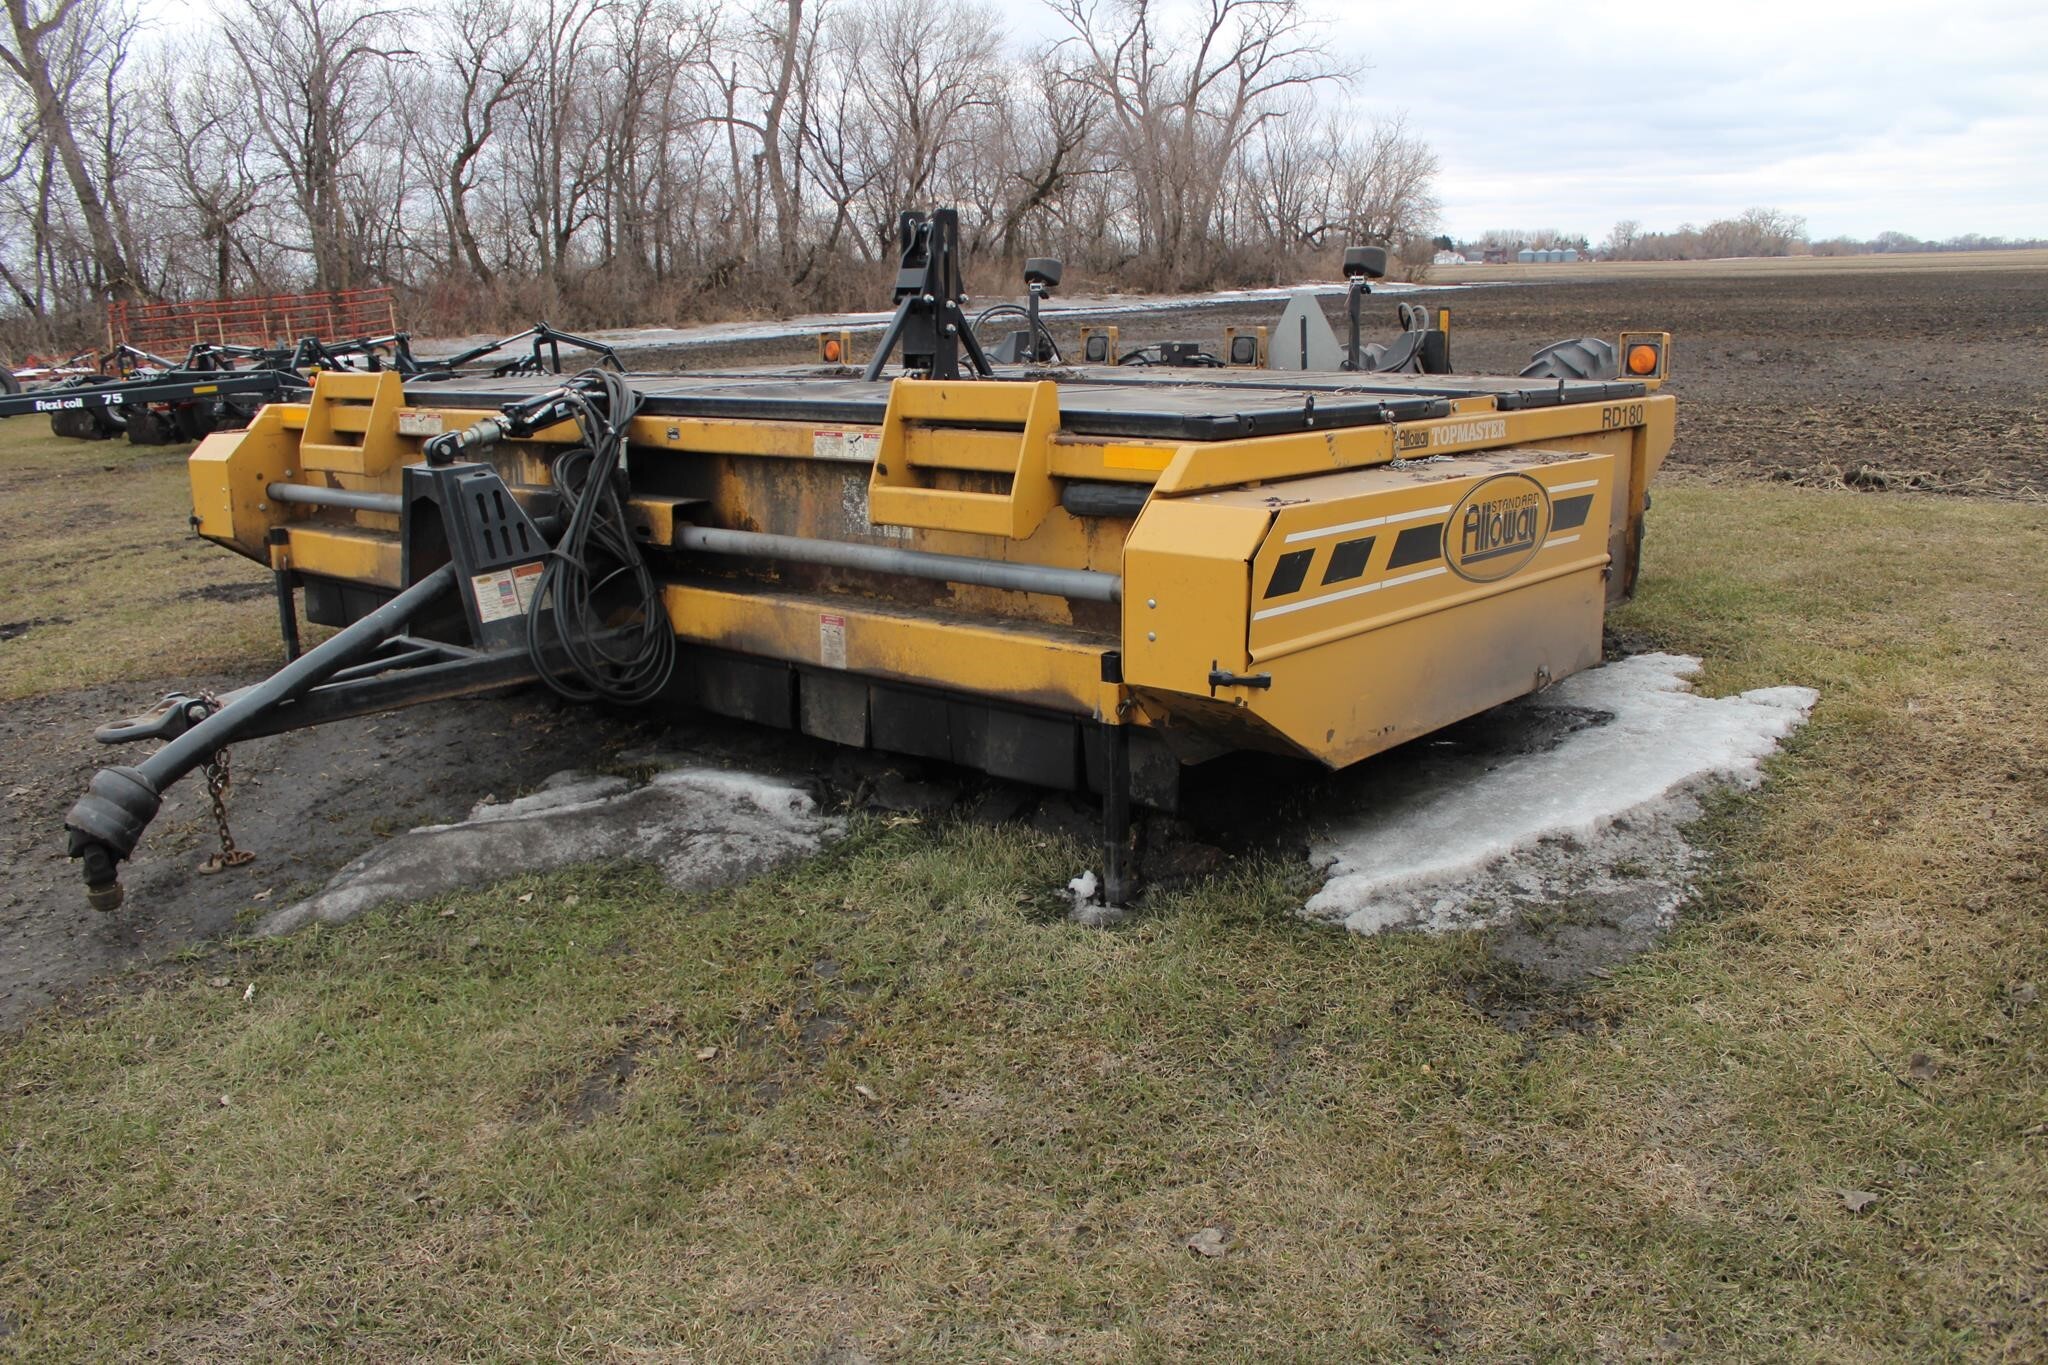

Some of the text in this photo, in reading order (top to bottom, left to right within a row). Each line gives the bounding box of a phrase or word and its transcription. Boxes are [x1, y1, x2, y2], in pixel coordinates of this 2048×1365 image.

[101, 393, 123, 405] 75
[1601, 405, 1643, 429] RD180
[1399, 419, 1507, 449] Alloway TOPMASTER
[1491, 492, 1540, 513] STANDARD
[1461, 502, 1538, 562] Alloway
